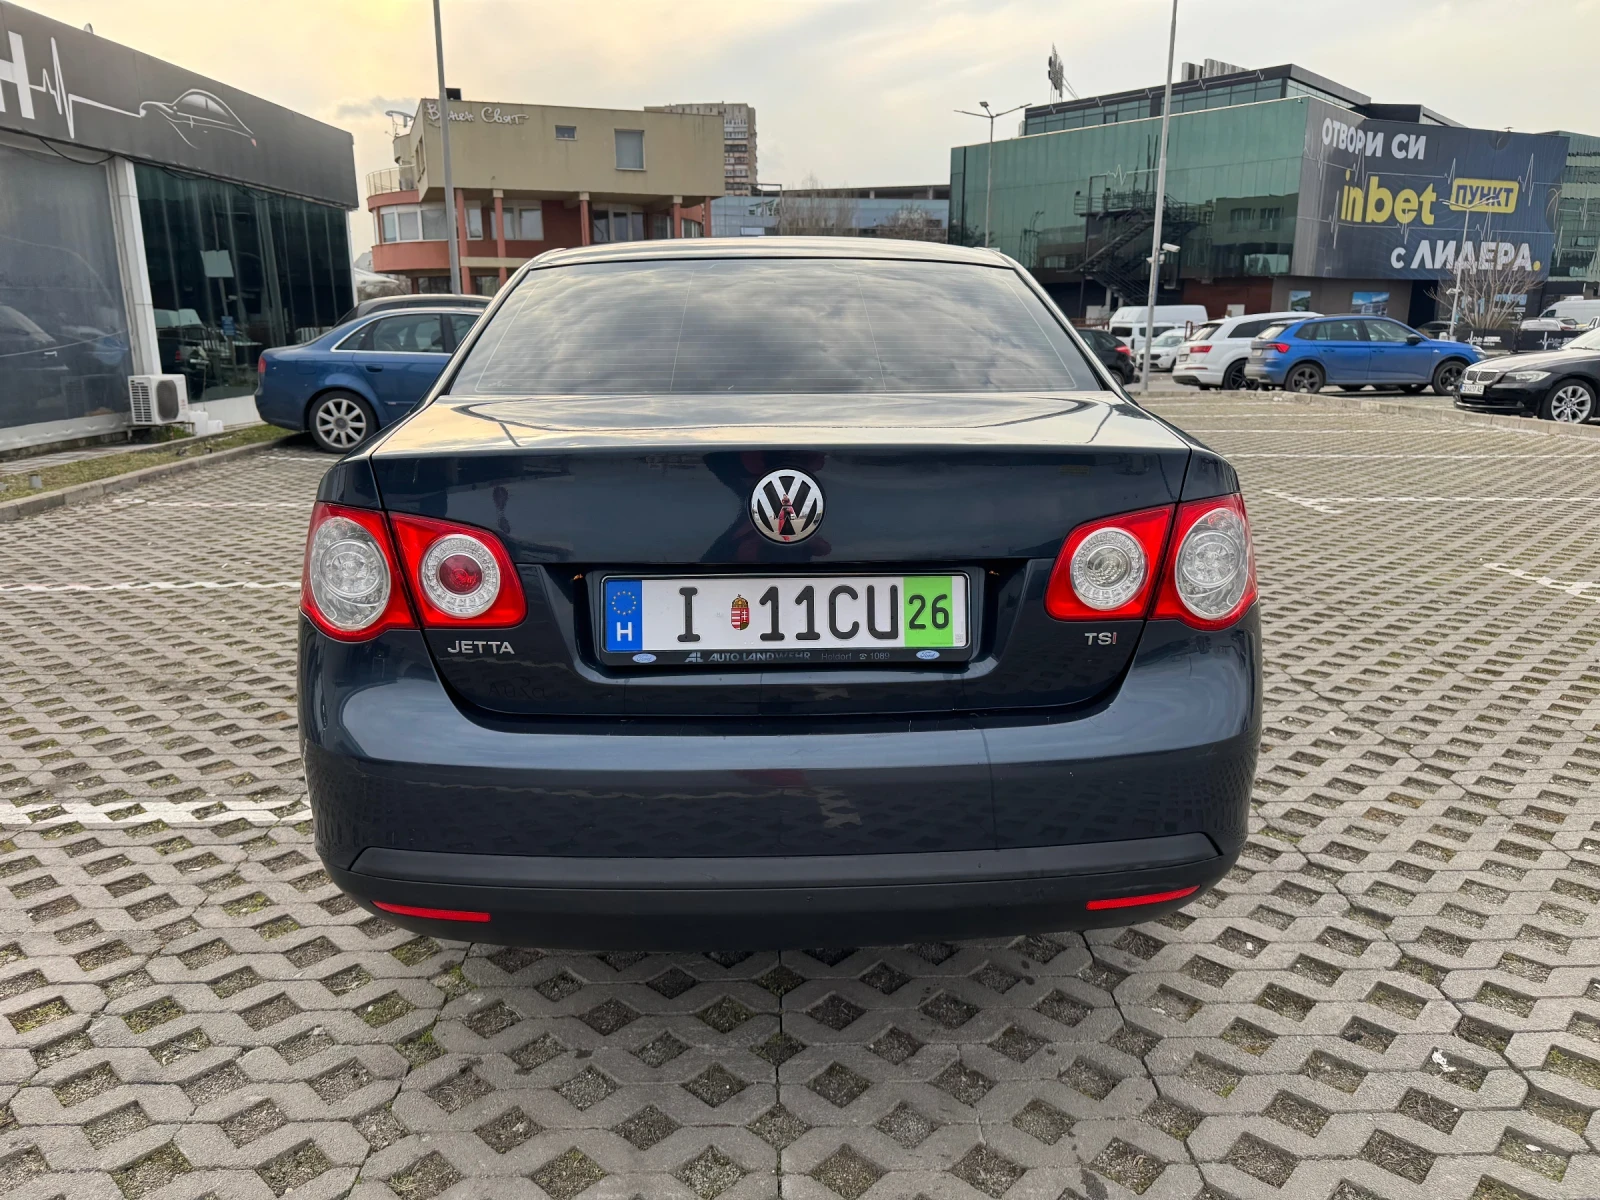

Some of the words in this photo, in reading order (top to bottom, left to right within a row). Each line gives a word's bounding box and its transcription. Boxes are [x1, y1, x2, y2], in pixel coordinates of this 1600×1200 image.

[1322, 117, 1384, 158] ОТВОРИ
[1391, 133, 1426, 160] СИ
[1341, 169, 1437, 226] inbet
[1456, 184, 1515, 208] ПУНКТ
[759, 584, 899, 642] 11CU
[908, 593, 950, 630] 26
[616, 621, 633, 642] H
[1084, 631, 1118, 646] TSI
[447, 640, 516, 655] JETTA
[708, 652, 740, 662] AUTO
